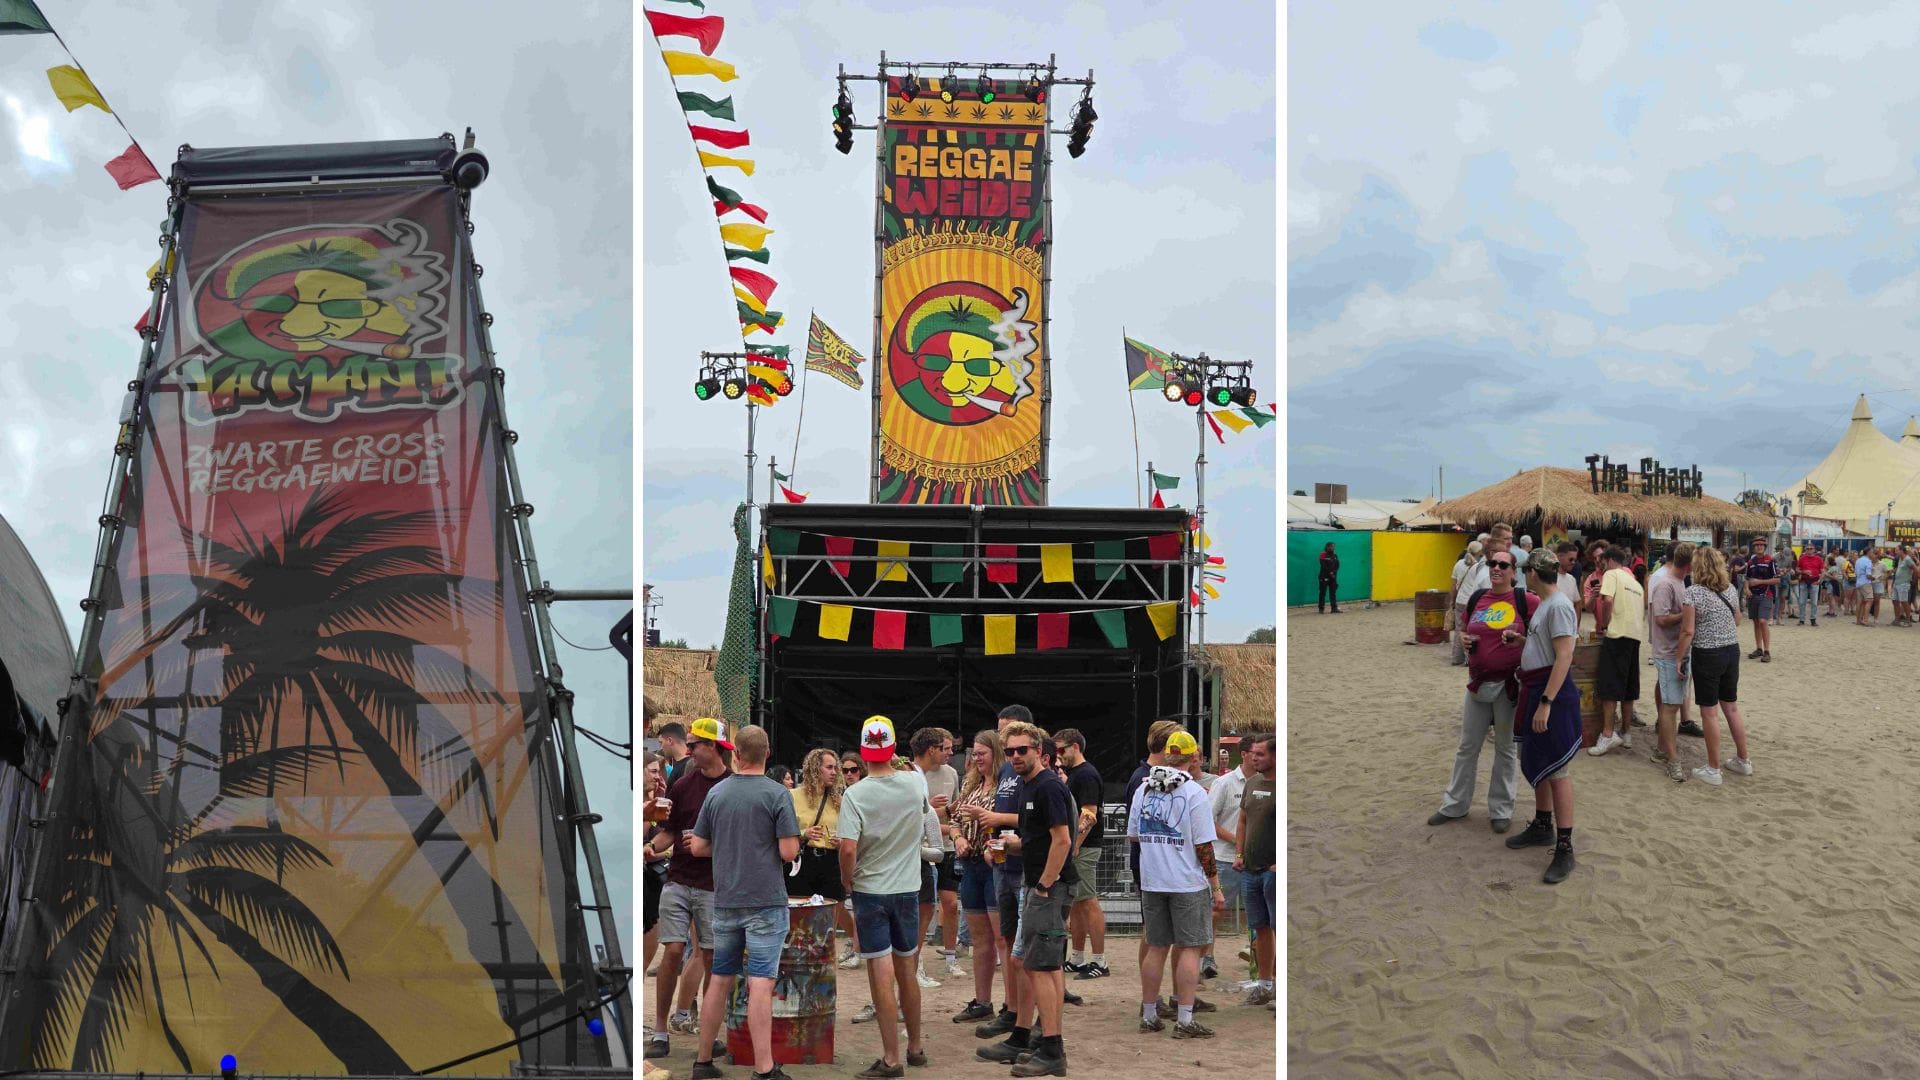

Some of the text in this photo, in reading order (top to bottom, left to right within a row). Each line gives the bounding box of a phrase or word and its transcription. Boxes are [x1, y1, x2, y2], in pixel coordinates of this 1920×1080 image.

[895, 145, 1033, 182] REGGAE
[185, 432, 446, 469] ZWARTE CROSS
[188, 457, 441, 495] REGGAEWEIDE
[1585, 453, 1629, 495] The
[1640, 457, 1703, 500] Shack
